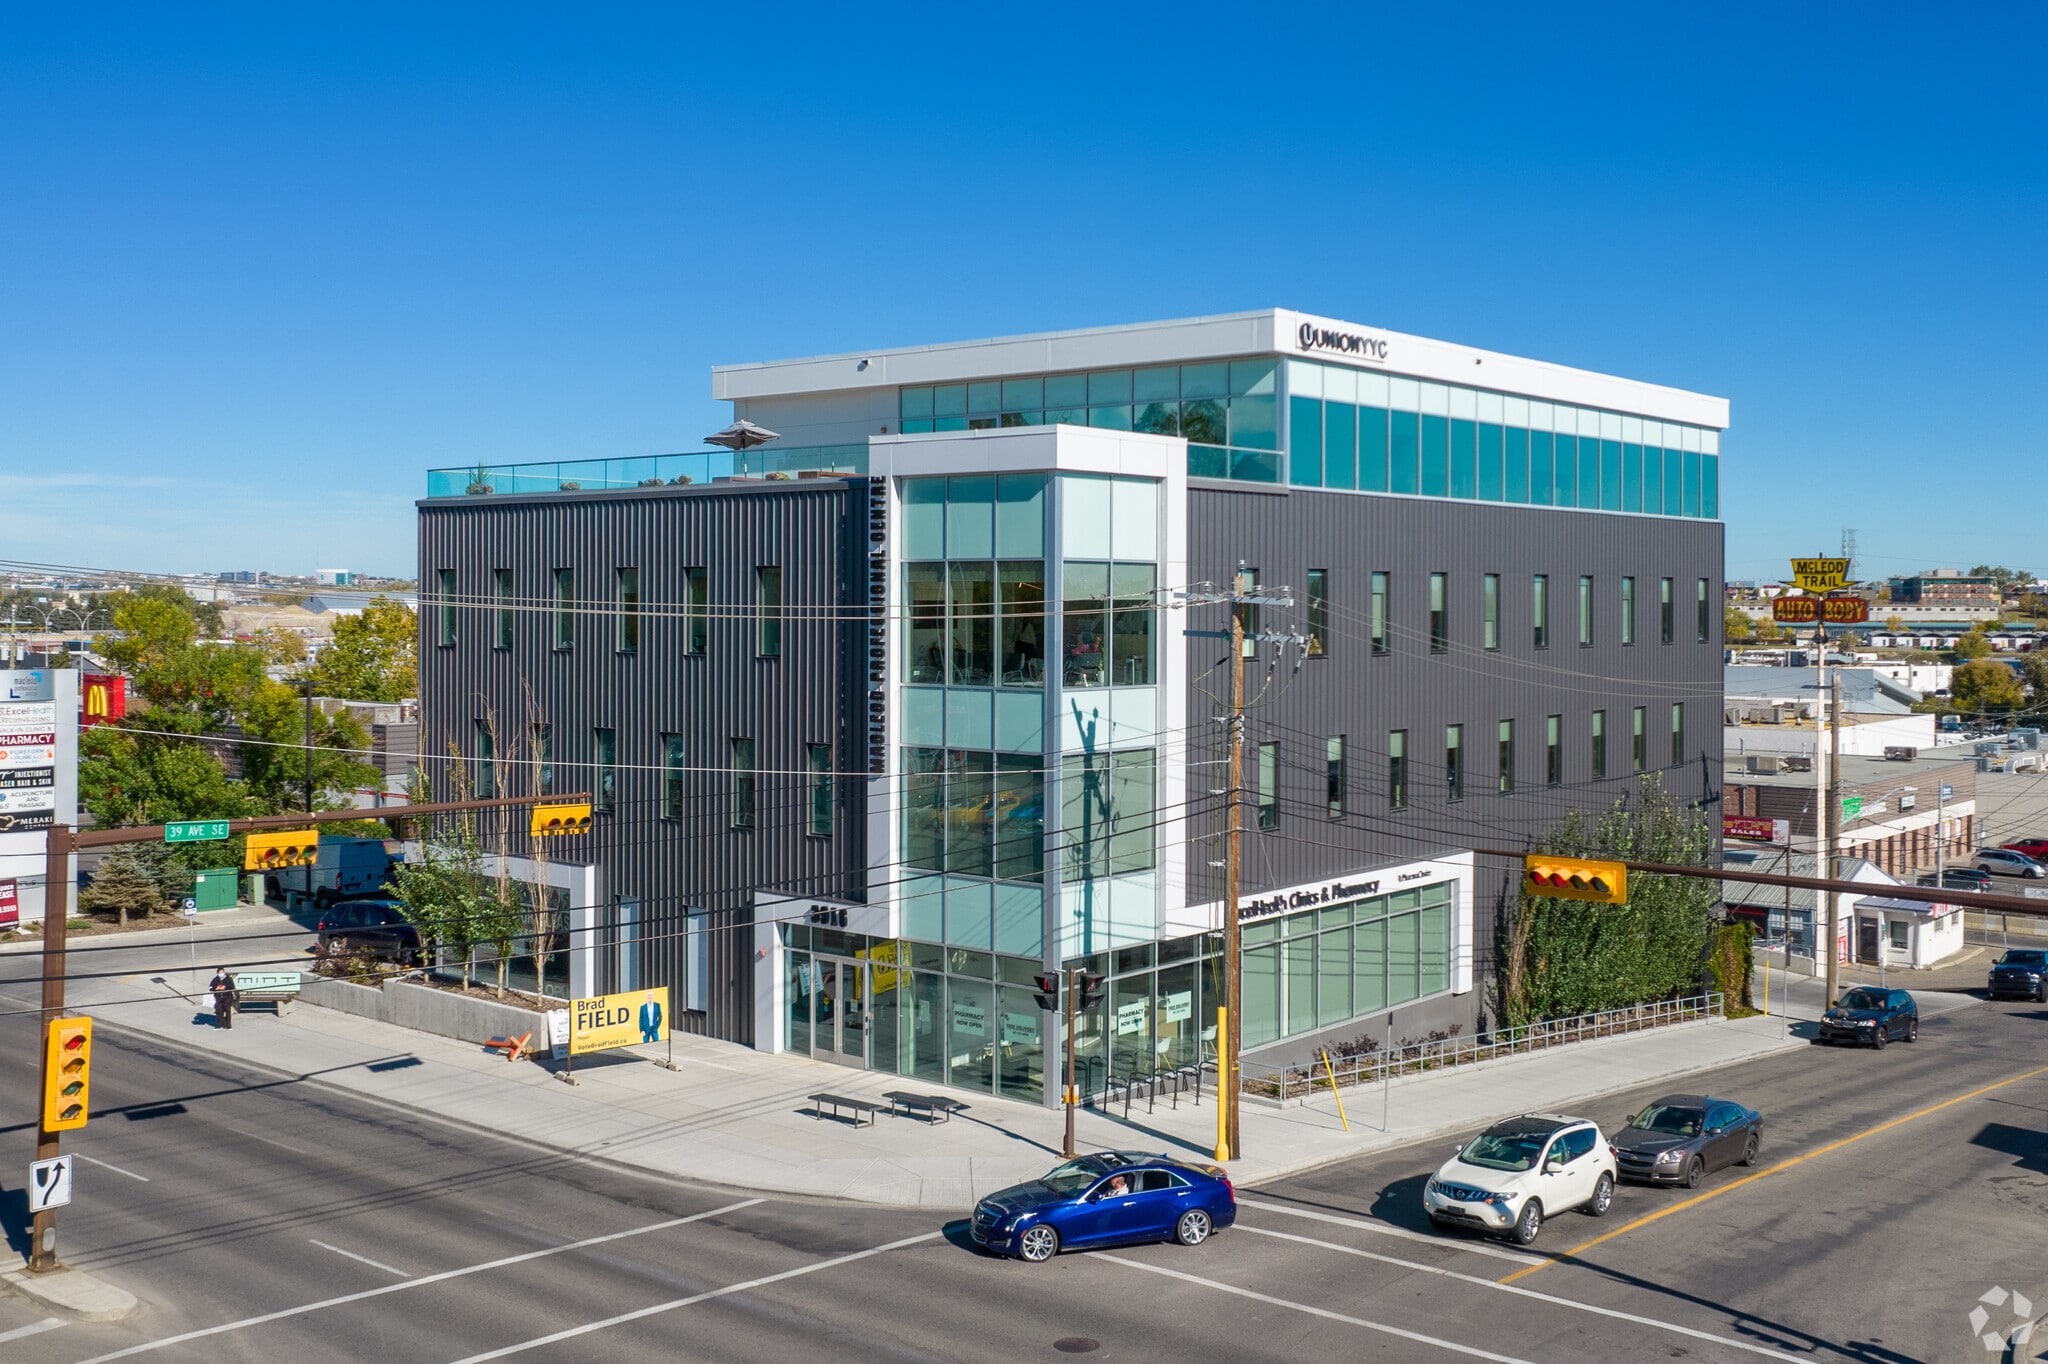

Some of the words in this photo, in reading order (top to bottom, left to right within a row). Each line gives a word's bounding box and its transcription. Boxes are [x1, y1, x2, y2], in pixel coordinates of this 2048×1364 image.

[869, 475, 886, 543] CENTRE
[1803, 575, 1839, 587] TRAIL
[1776, 601, 1815, 619] AUTO
[1825, 601, 1865, 619] BODY
[869, 691, 886, 773] MACLEOD
[0, 734, 52, 745] PHARMACY
[0, 780, 16, 788] ASER
[20, 816, 53, 825] MERAKI
[170, 827, 182, 838] 39
[188, 825, 205, 836] AVE
[212, 824, 224, 835] SE
[1320, 887, 1330, 903] &
[1331, 880, 1380, 900] Pharmacy
[577, 997, 605, 1012] Brad
[578, 1007, 630, 1030] FIELD
[954, 1010, 985, 1021] PHARMACY
[1119, 1008, 1144, 1018] PHARMACY
[969, 1021, 982, 1029] OPEN
